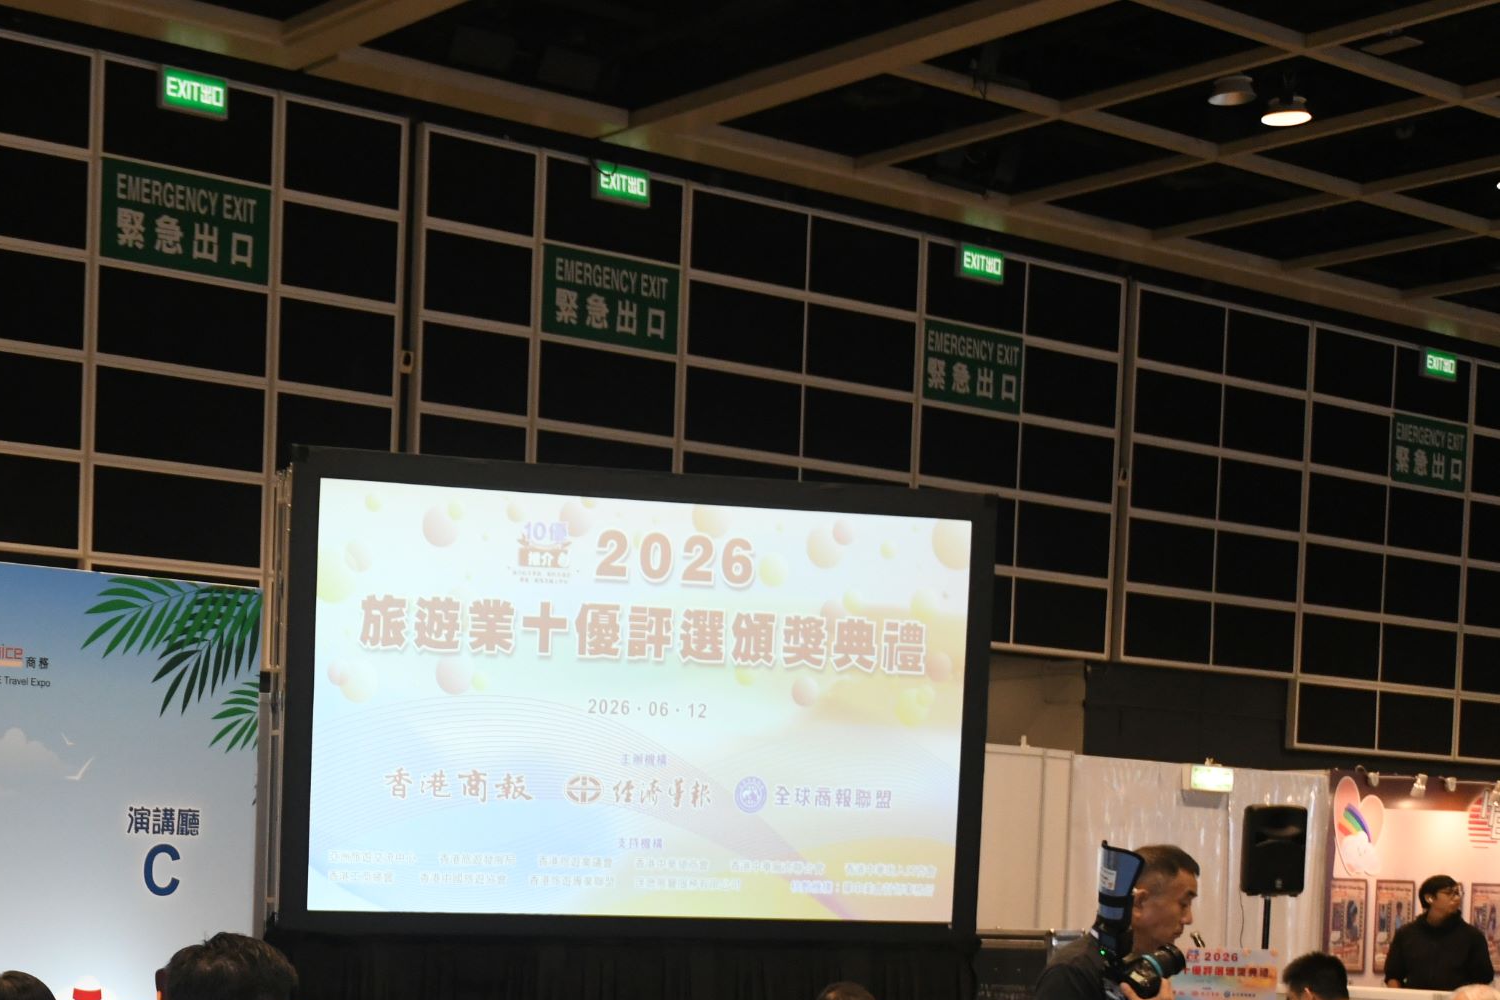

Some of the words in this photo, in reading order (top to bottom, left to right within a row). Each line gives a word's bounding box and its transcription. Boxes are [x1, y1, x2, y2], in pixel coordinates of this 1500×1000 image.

[116, 172, 220, 217] EMERGENCY
[223, 194, 257, 224] EXIT
[116, 206, 254, 268] 緊急出口
[556, 257, 638, 294] EMERGENCY
[641, 274, 669, 300] EXIT
[556, 287, 666, 340] 緊急出口
[928, 330, 995, 363] EMERGENCY
[997, 344, 1019, 367] EXIT
[927, 357, 1017, 402] 緊急出口
[1396, 422, 1446, 449] EMERGENCY
[1447, 432, 1465, 452] EXIT
[595, 529, 754, 585] 2026
[359, 594, 926, 674] 旅遊業十優評選頒獎典禮
[4, 676, 29, 686] Travel
[30, 678, 51, 689] Expo
[385, 768, 533, 803] 香港商報
[774, 786, 892, 809] 全球商報聯盟
[127, 806, 200, 836] 演講廳
[144, 844, 180, 896] C
[1204, 952, 1238, 962] 2026
